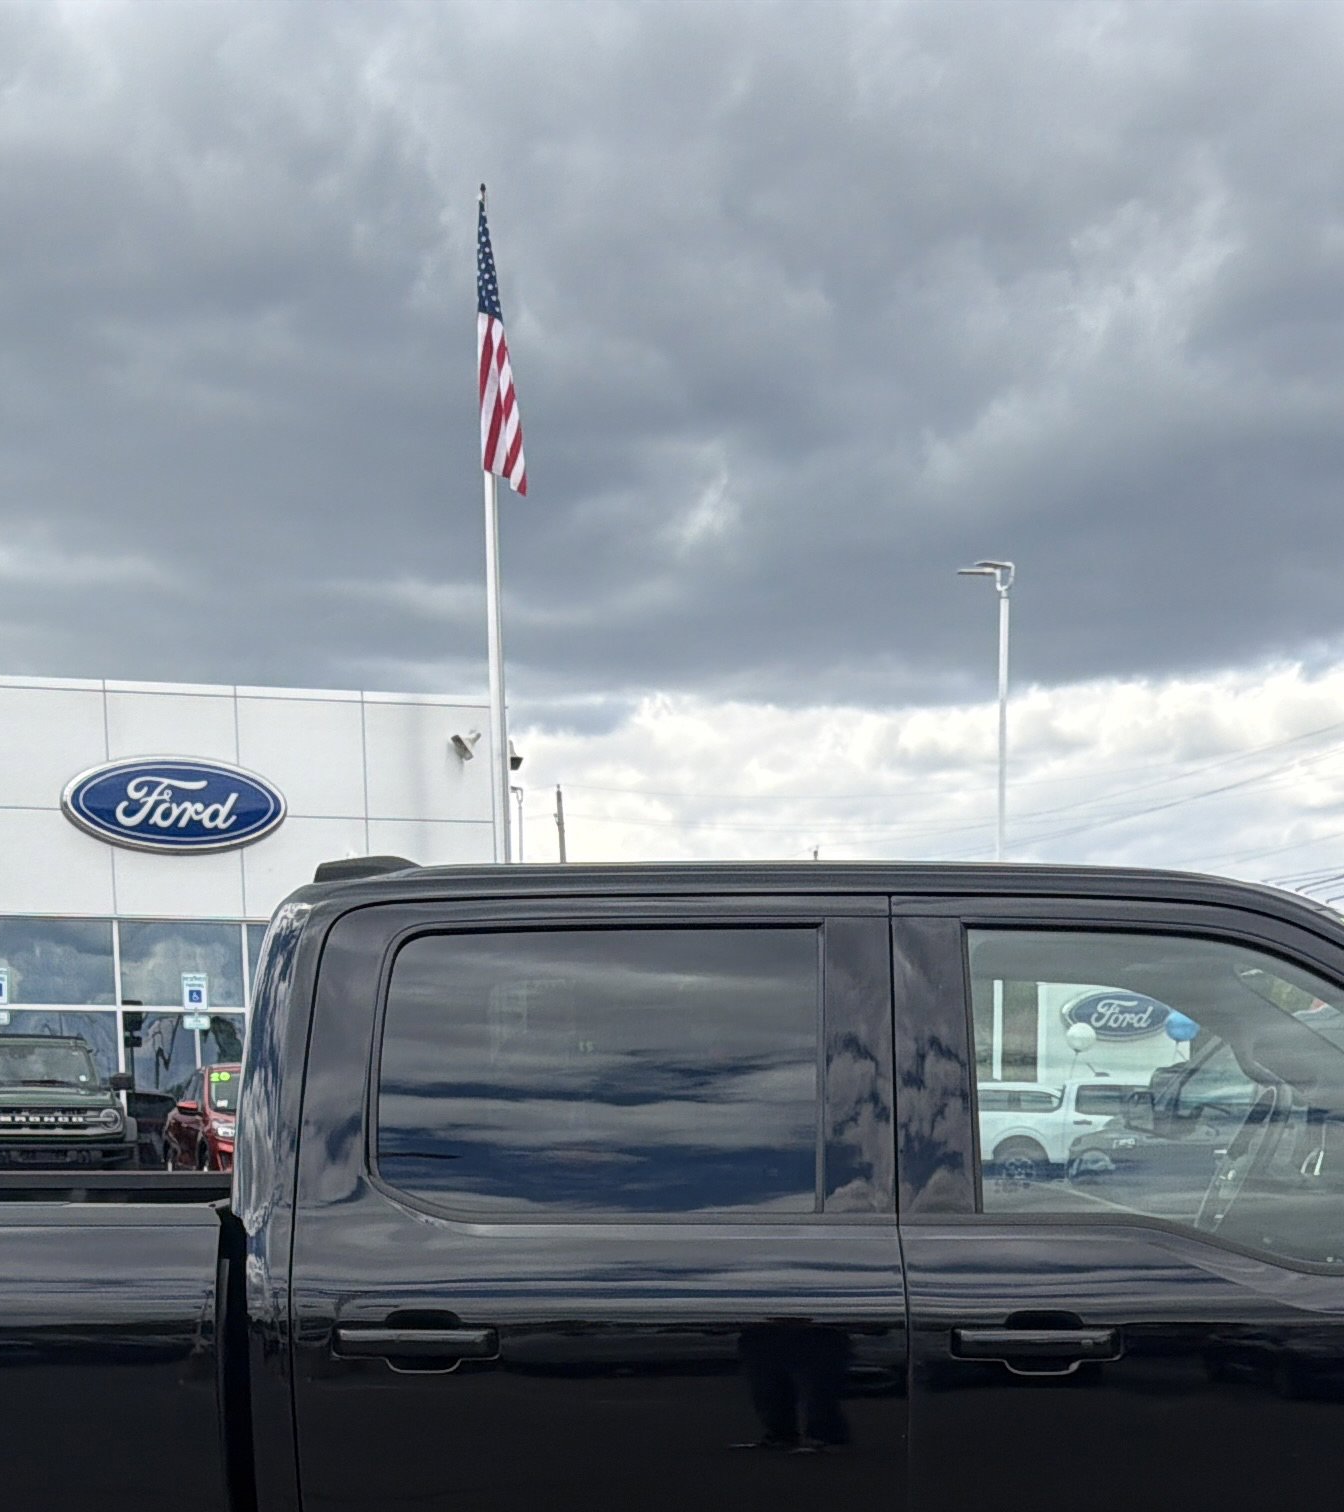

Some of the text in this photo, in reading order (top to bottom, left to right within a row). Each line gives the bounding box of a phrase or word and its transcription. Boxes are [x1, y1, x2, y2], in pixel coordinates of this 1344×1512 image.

[115, 776, 239, 830] Ford
[1091, 999, 1153, 1029] Ford
[210, 1071, 231, 1082] 20
